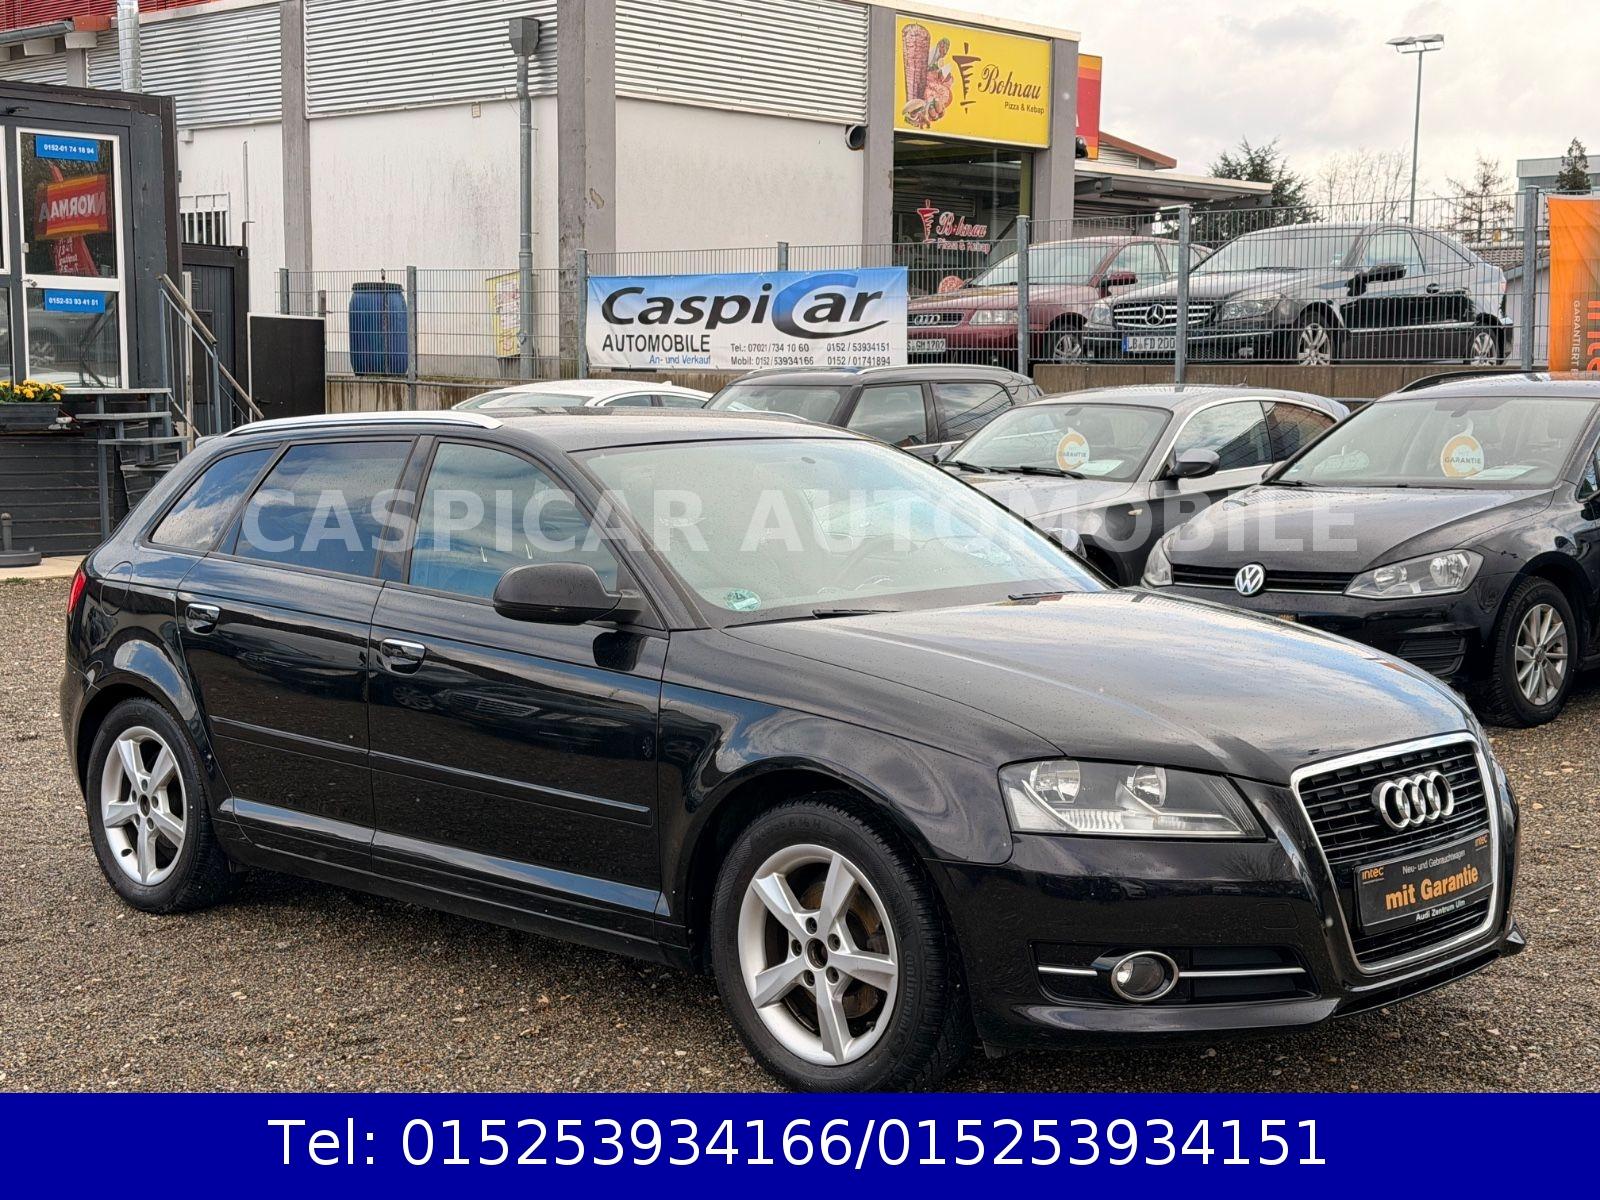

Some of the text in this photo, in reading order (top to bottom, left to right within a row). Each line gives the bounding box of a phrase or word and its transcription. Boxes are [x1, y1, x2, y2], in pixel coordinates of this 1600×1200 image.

[977, 64, 1042, 99] Bohnau
[1005, 101, 1045, 115] Pizza & Kebap
[44, 143, 68, 152] 0152-01
[602, 273, 889, 339] CaspiCar
[1571, 300, 1581, 366] GARANTIERT
[602, 334, 711, 352] AUTOMOBILE
[730, 343, 747, 352] Tel.:
[787, 343, 796, 352] 10
[798, 343, 810, 352] 60
[827, 342, 846, 352] 0152
[852, 342, 890, 352] 53934151
[1144, 338, 1155, 349] FD
[649, 354, 711, 364] An- und Verkauf
[730, 356, 754, 365] Mobil:
[827, 356, 846, 365] 0152
[852, 356, 891, 366] 01741894
[1474, 833, 1489, 847] intec
[1361, 866, 1384, 880] intec
[1402, 865, 1417, 875] Neu-
[1417, 861, 1428, 871] und
[1385, 863, 1479, 910] mit Garantie
[1416, 899, 1466, 921] Audi Zentrum Ulm
